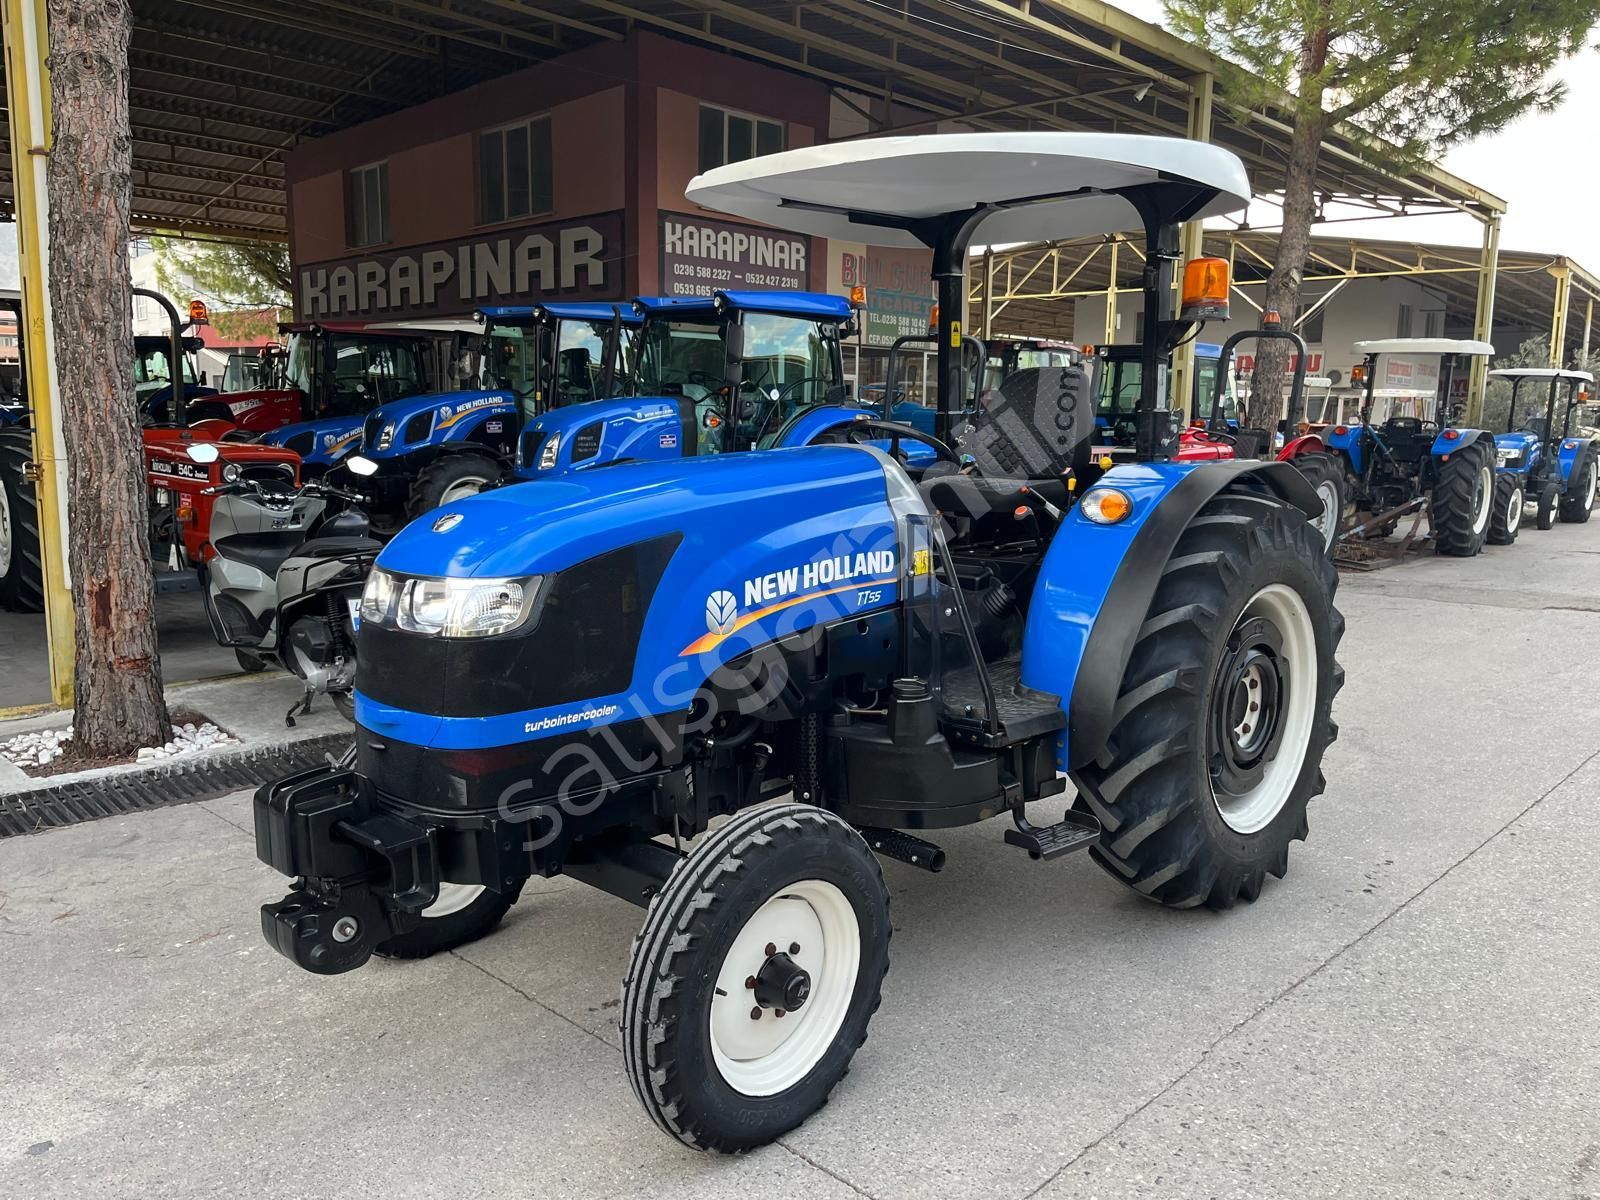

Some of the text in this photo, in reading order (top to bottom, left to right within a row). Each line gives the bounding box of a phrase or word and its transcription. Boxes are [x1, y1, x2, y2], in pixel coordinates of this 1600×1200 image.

[664, 221, 806, 272] KARAPINAR
[302, 225, 604, 315] KARAPINAR
[673, 263, 695, 277] 0236
[696, 266, 712, 279] 588
[712, 269, 732, 281] 2327
[745, 272, 765, 284] 0532
[765, 275, 781, 287] 427
[781, 277, 799, 289] 2319
[673, 282, 695, 295] 0533
[695, 284, 711, 297] 665
[456, 396, 503, 413] NEW HOLLAND
[178, 463, 194, 478] 54C
[744, 566, 799, 607] NEW
[803, 550, 895, 589] HOLLAND
[857, 590, 882, 606] TT55
[524, 704, 617, 733] turbointercooler
